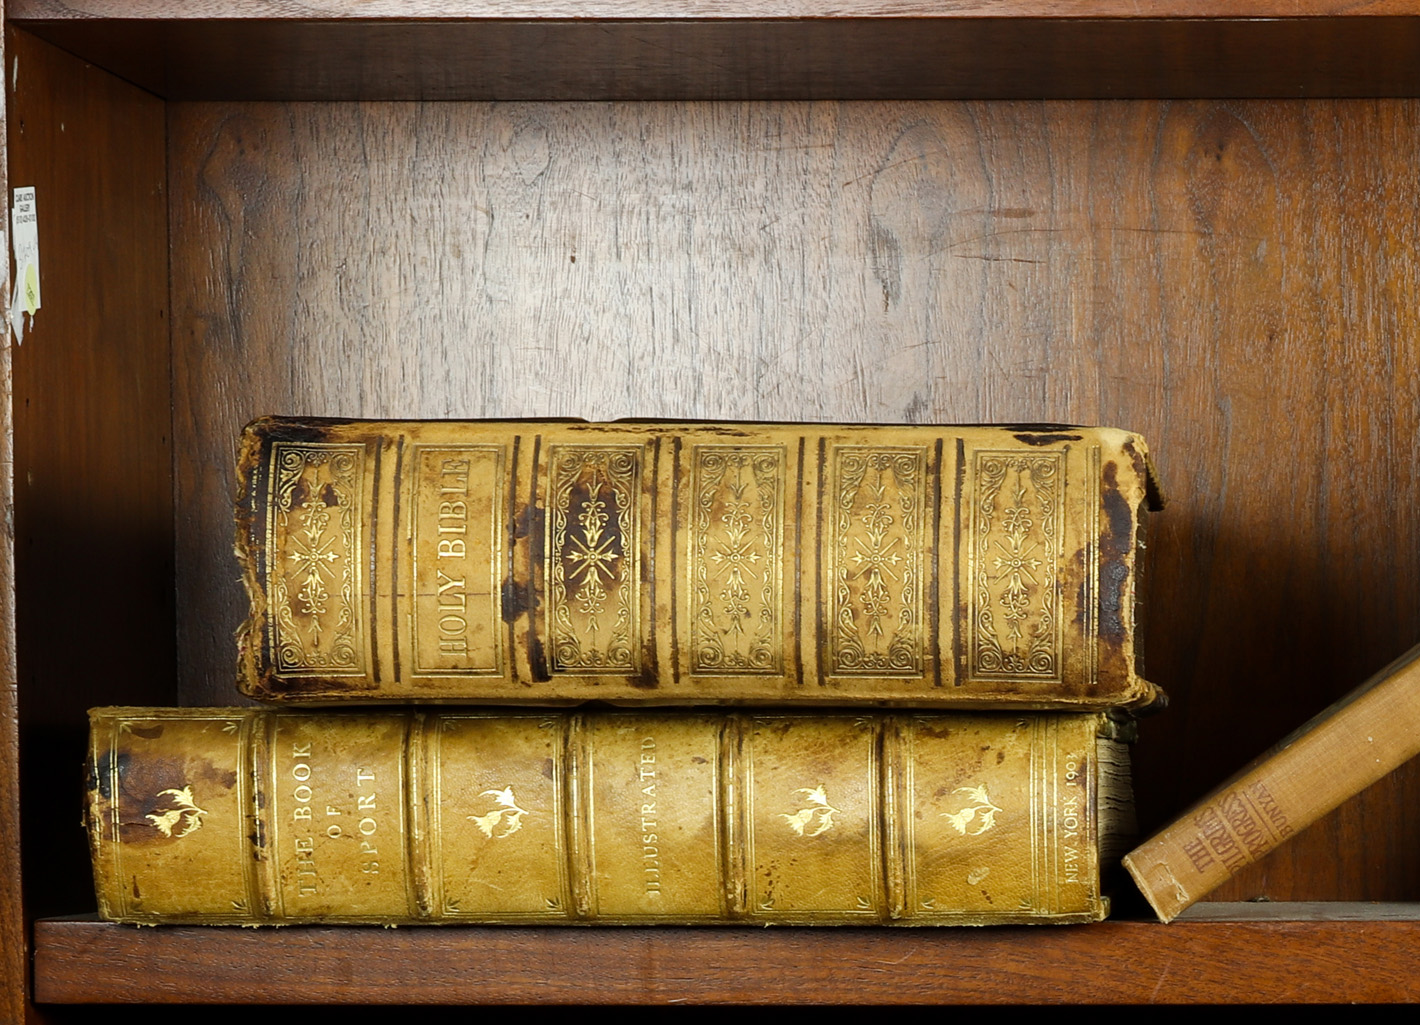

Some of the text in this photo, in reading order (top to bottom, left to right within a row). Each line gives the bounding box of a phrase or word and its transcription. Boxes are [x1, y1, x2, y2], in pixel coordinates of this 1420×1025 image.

[437, 458, 471, 658] HOLY BIBLE
[292, 742, 317, 896] THE BOOK
[325, 805, 341, 838] OF
[356, 768, 379, 873] SPORT
[640, 736, 660, 894] ILLUSTRATED
[1063, 795, 1078, 838] YORK
[1220, 791, 1271, 860] PROGRESS
[1248, 779, 1294, 839] BUNYAN
[1064, 845, 1078, 882] NEW
[1181, 837, 1215, 873] THE
